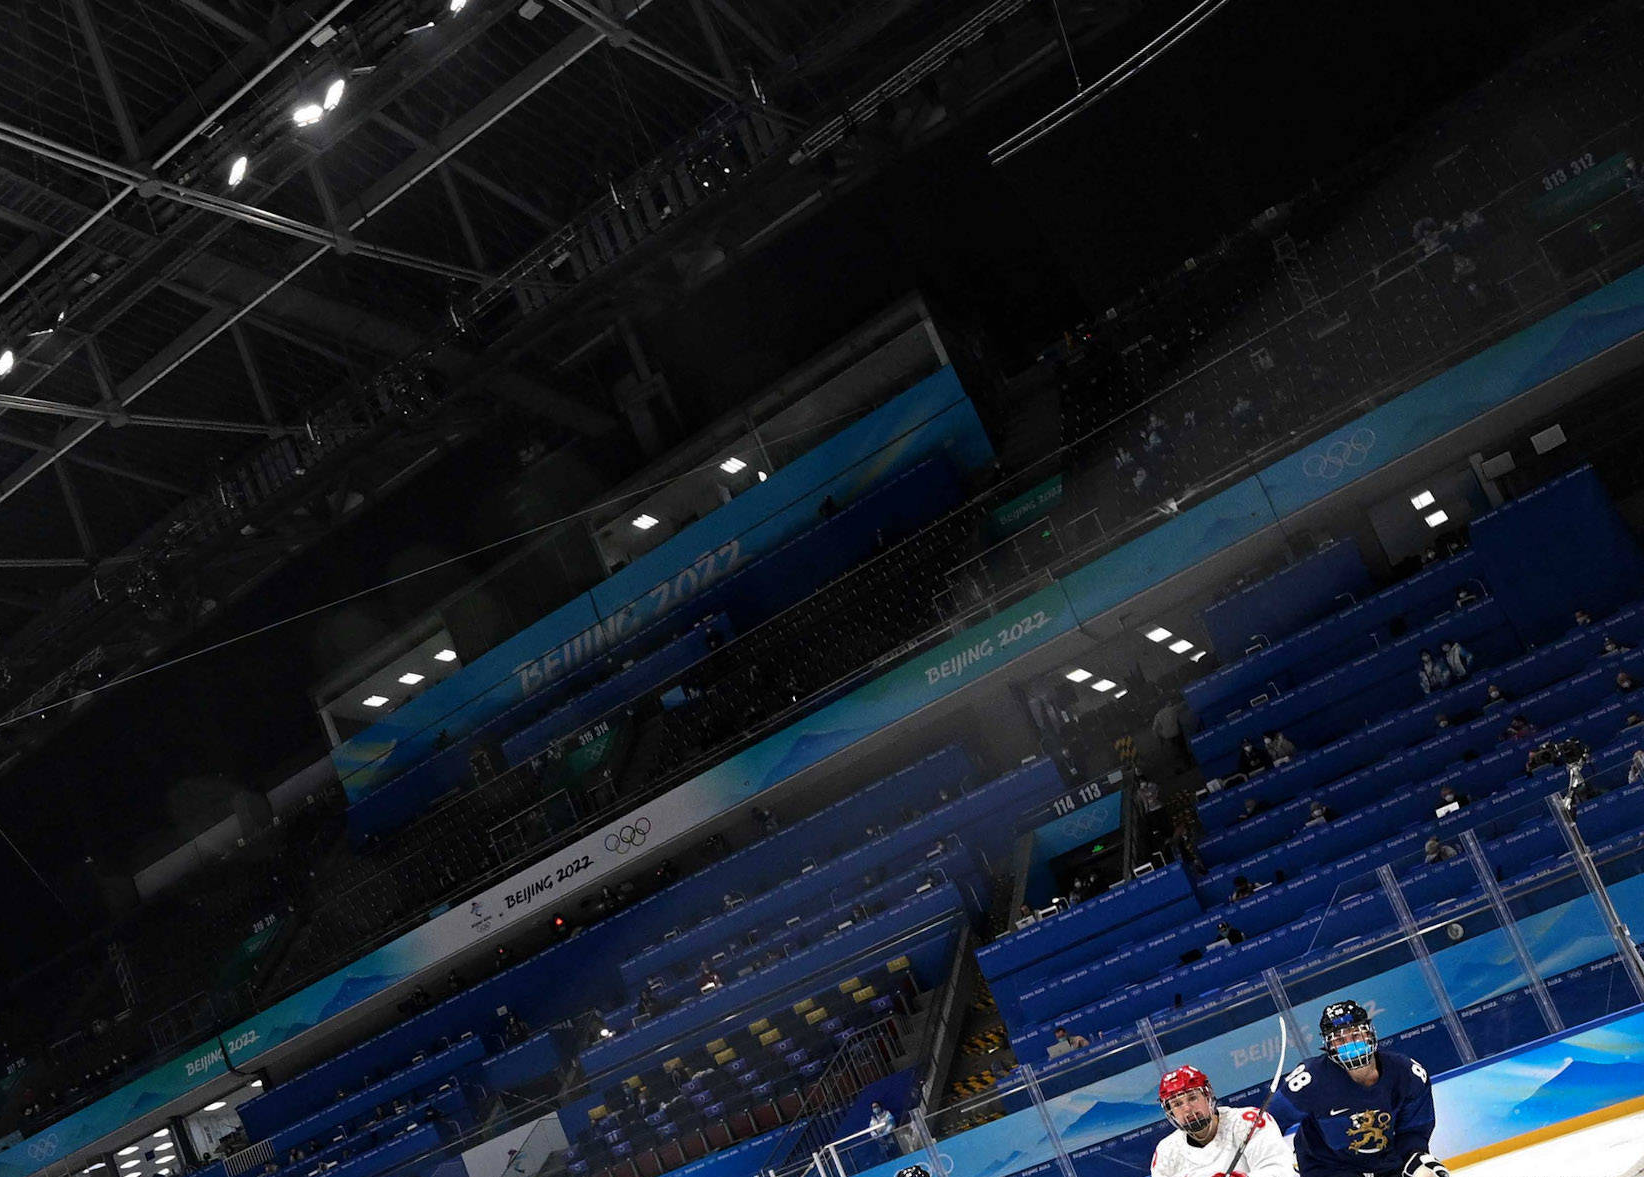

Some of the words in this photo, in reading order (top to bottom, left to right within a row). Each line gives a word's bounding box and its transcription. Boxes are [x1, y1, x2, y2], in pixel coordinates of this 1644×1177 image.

[1541, 169, 1568, 192] 313
[1569, 152, 1597, 175] 312
[924, 638, 995, 686] BEIJING
[997, 610, 1053, 644] 2022
[1052, 797, 1076, 817] 114
[1079, 783, 1102, 803] 113
[504, 876, 554, 910] BEIJING
[556, 855, 595, 883] 2022
[185, 1048, 227, 1078] BEIJING
[227, 1029, 261, 1056] 2022
